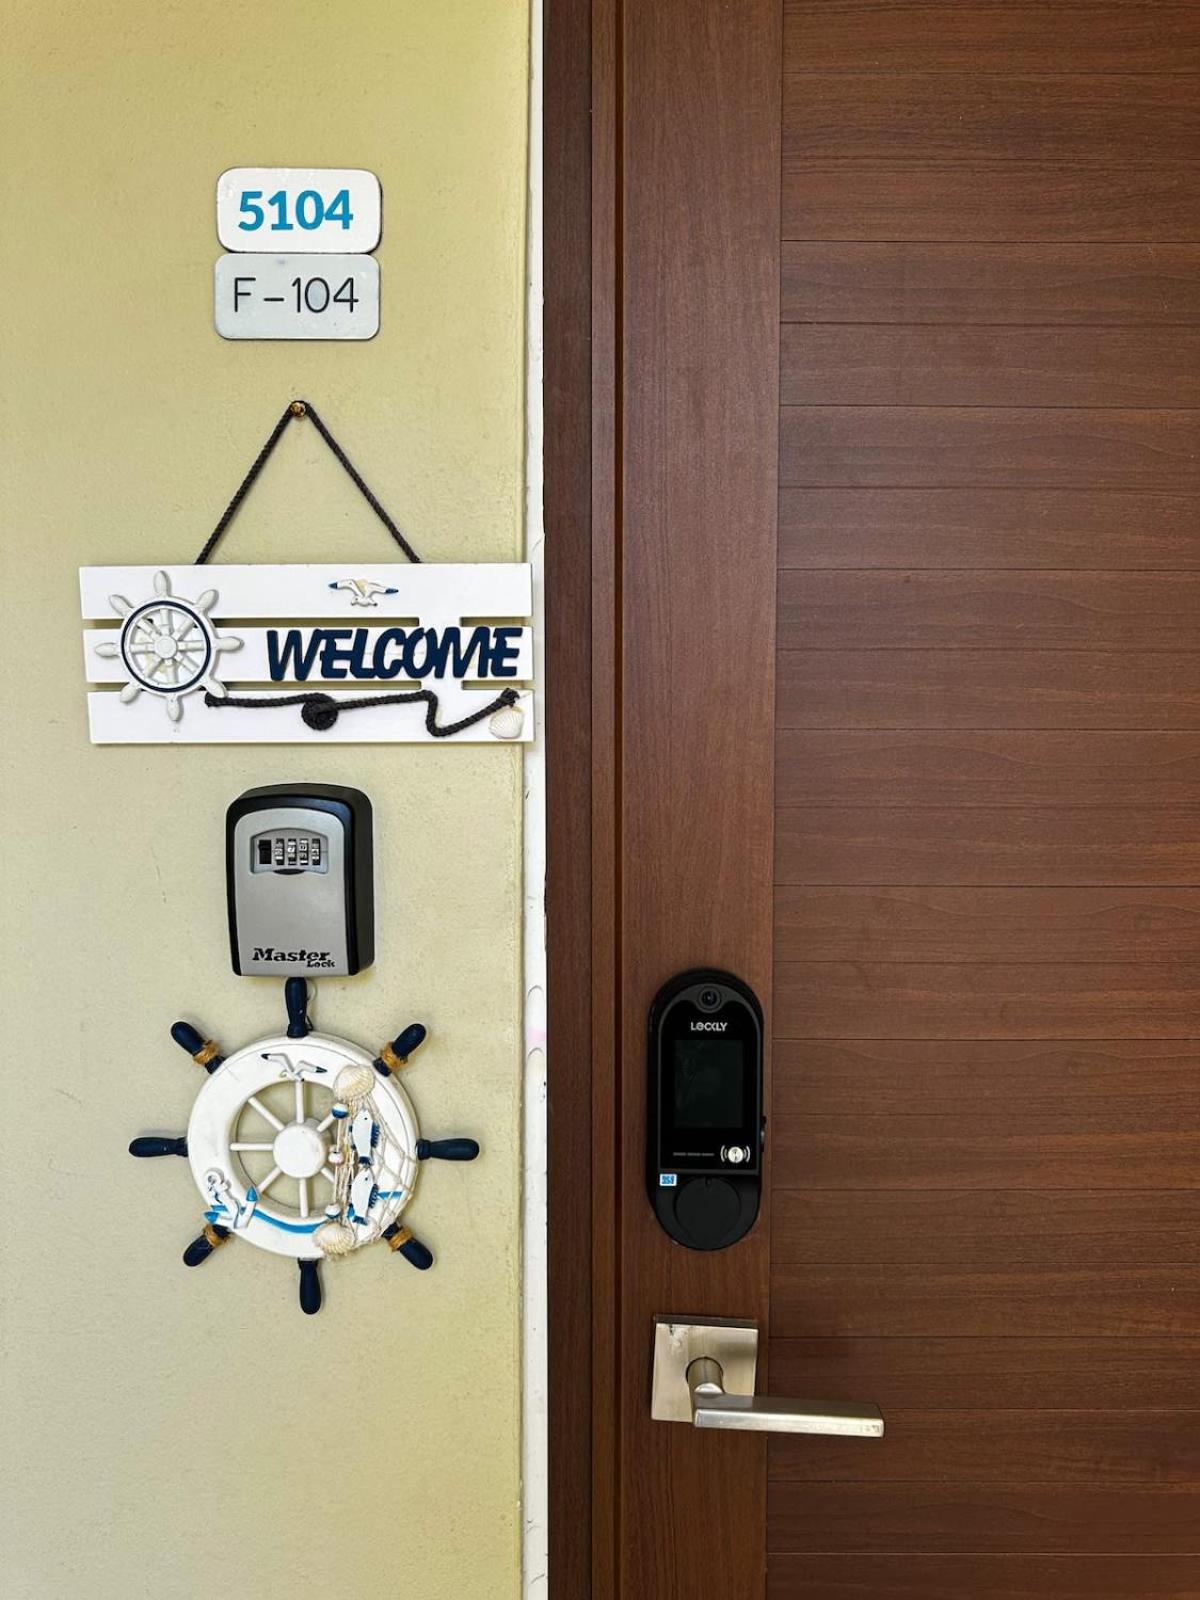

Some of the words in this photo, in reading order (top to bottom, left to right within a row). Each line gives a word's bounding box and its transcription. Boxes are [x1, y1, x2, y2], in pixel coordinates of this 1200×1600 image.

[238, 189, 354, 231] 5104
[266, 626, 523, 681] WELCOME
[252, 947, 331, 962] Master
[306, 960, 336, 968] Lock
